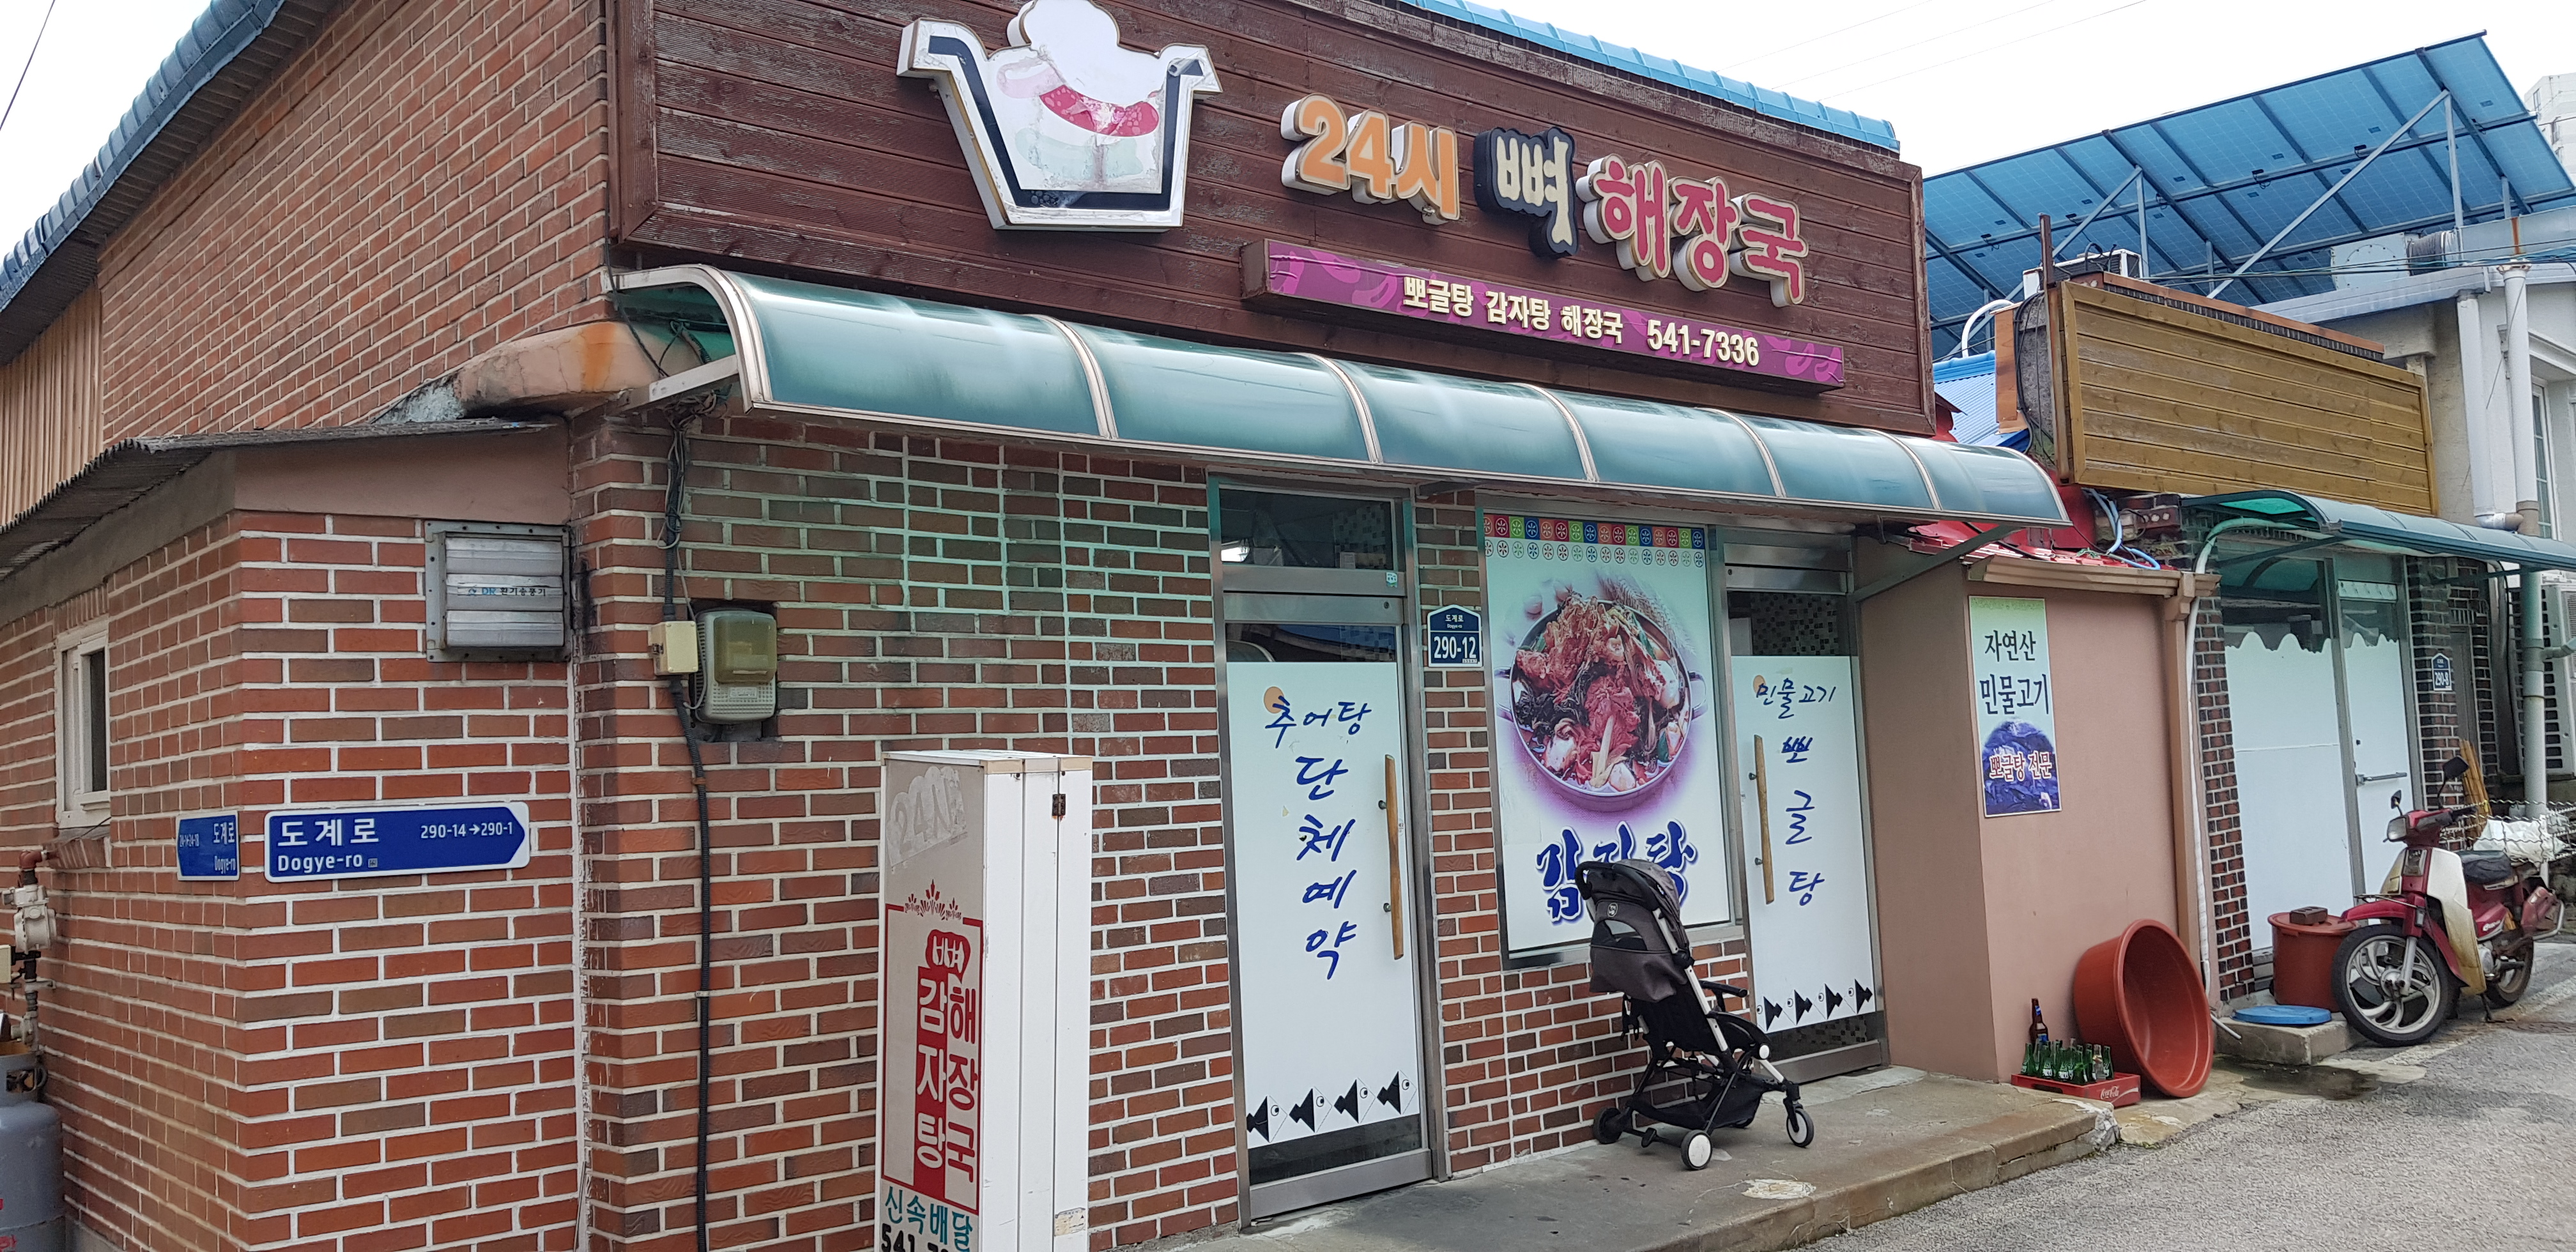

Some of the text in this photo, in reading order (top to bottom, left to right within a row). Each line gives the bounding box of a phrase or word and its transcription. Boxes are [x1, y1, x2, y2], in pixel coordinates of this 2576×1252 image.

[1292, 94, 1809, 305] 24시 뼈 해장국
[1403, 277, 1760, 367] 뽀글탕 감자탕 해장국 541-7336
[1445, 615, 1464, 623] 도계로
[1434, 636, 1476, 659] 290-12
[1985, 630, 2036, 662] 자연산
[1756, 678, 1836, 719] 민물고기
[1979, 674, 2049, 715] 민물고기
[1265, 696, 1372, 748] 추어탕
[1989, 751, 2051, 781] 뽀글탕 전문
[213, 821, 235, 845] 도계로
[277, 818, 512, 846] 도계로 290-14 290-1
[278, 854, 363, 873] Dogye-ro
[931, 935, 965, 974] 뼈
[916, 978, 947, 1170] 감자탕
[947, 985, 979, 1184] 해장국
